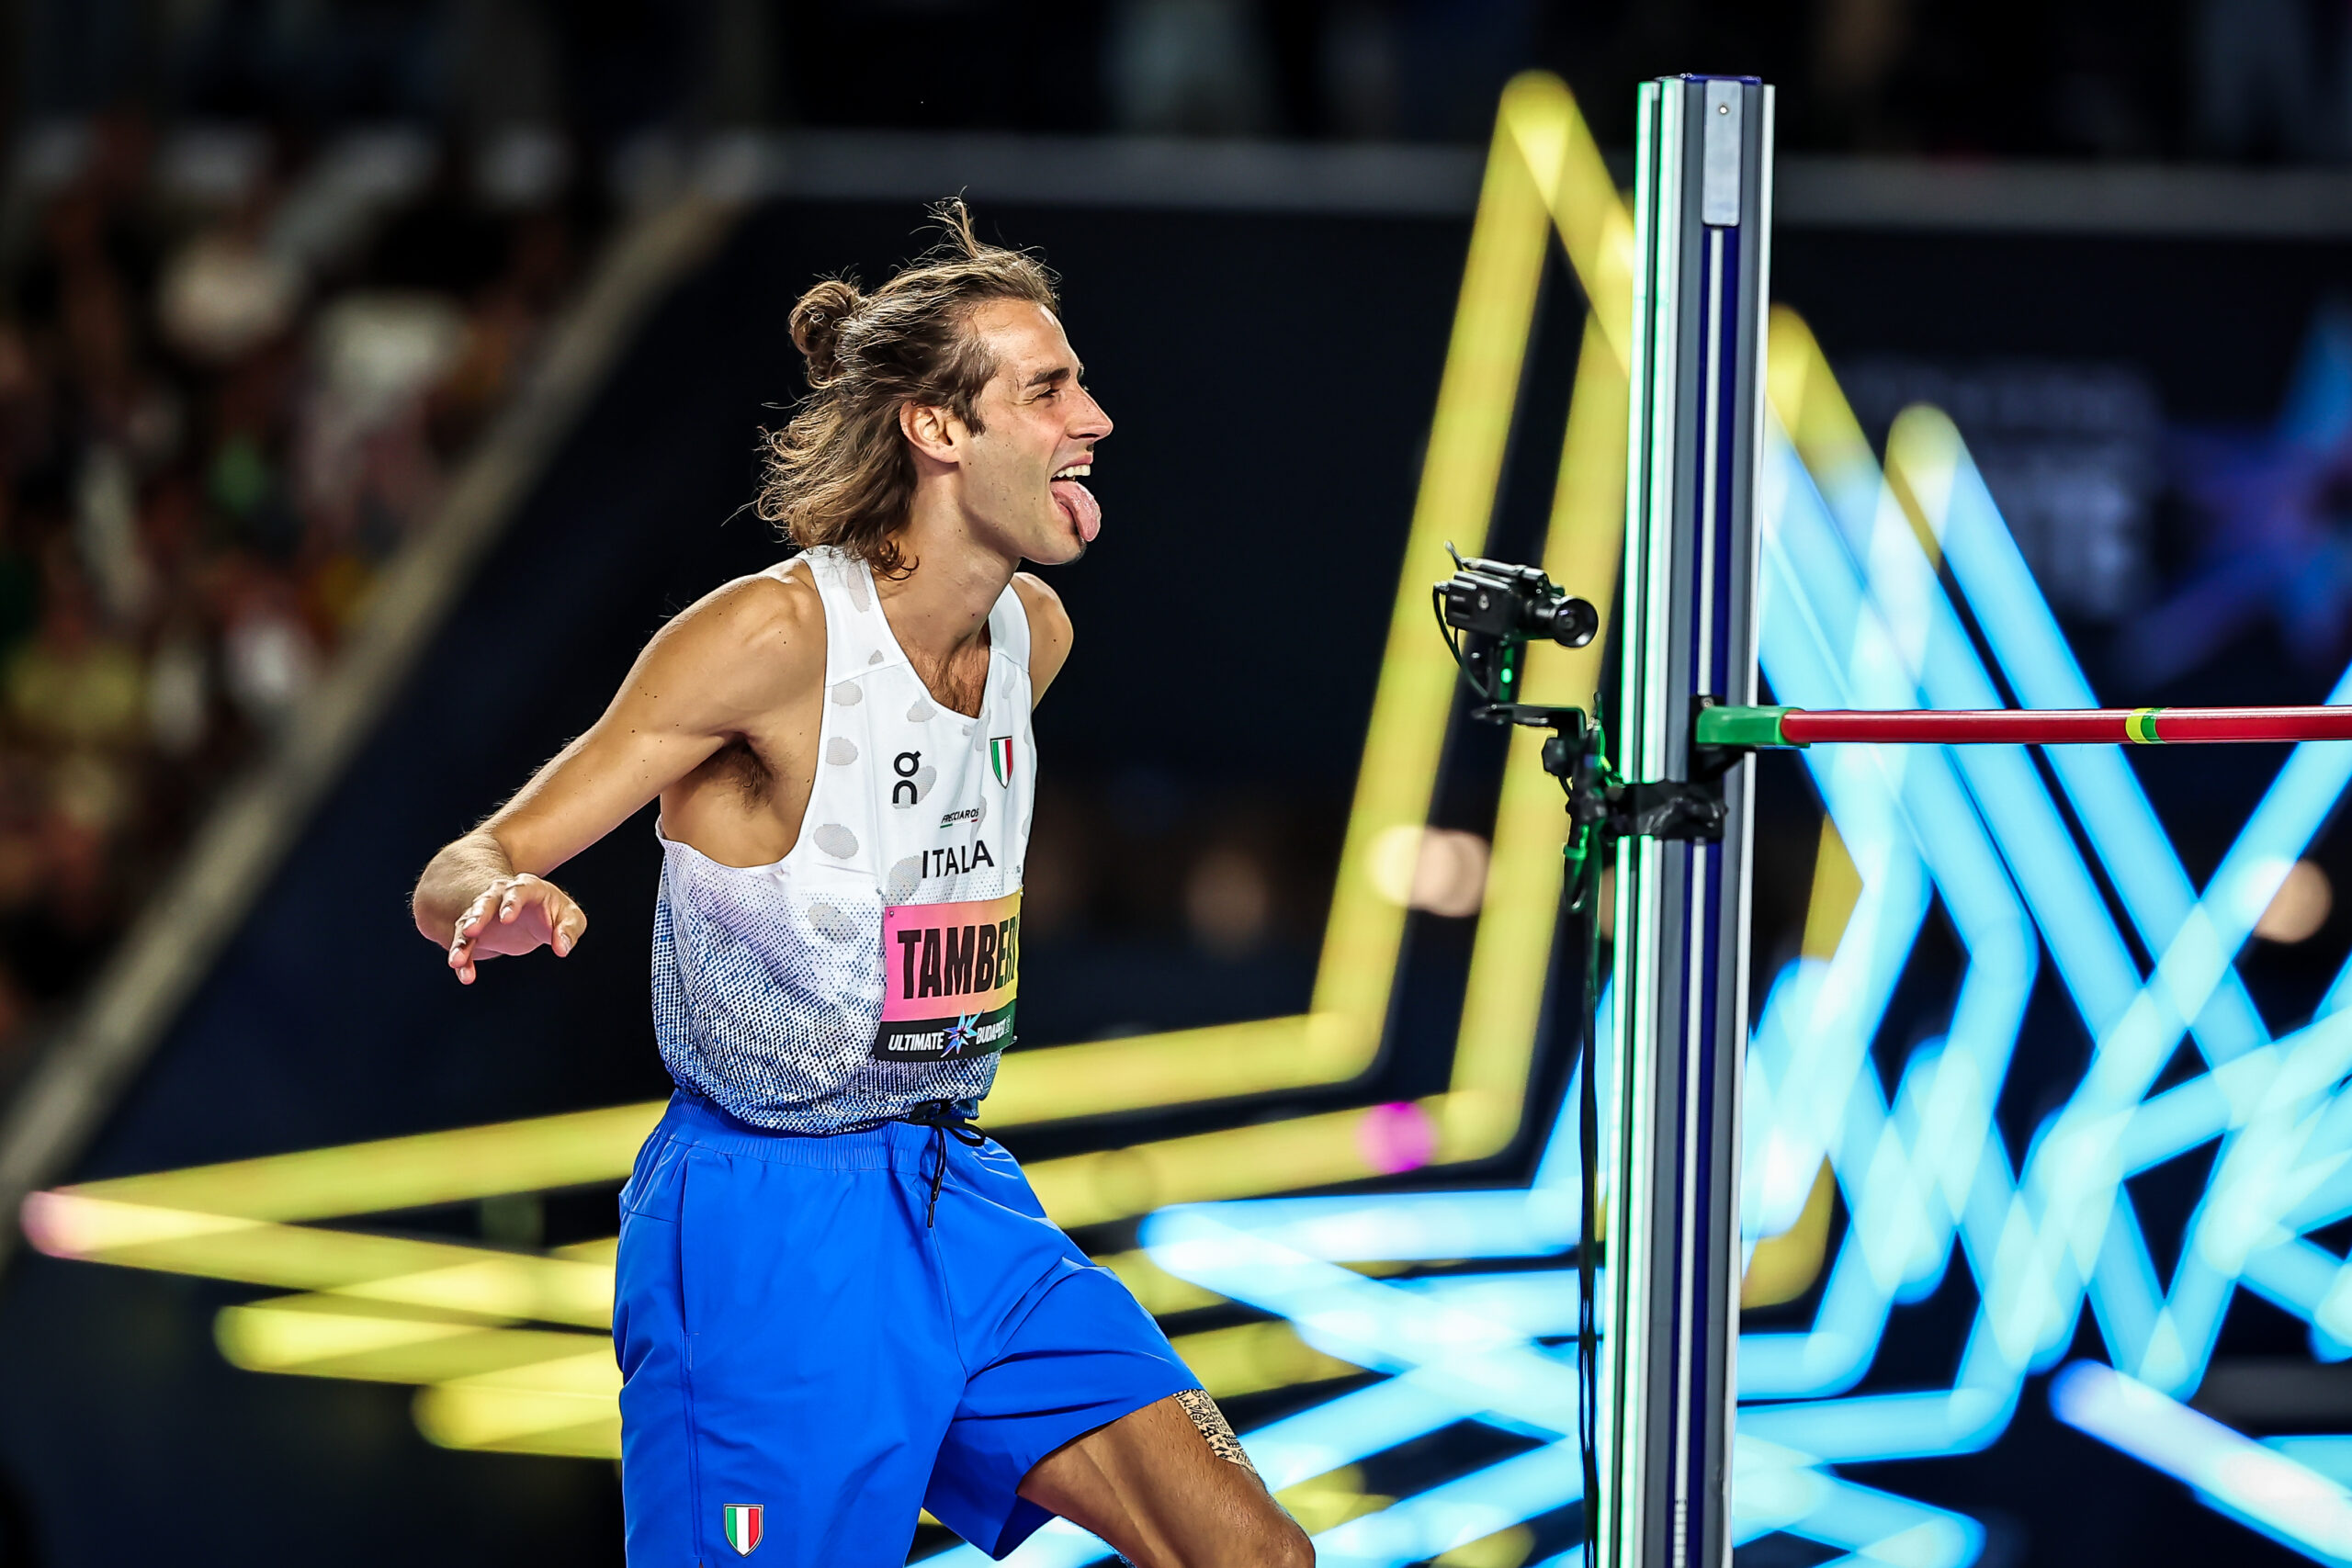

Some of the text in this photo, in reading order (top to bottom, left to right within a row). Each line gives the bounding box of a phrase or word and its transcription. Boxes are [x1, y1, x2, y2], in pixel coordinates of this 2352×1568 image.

[941, 807, 979, 823] FRECCIAROS
[922, 840, 994, 878] ITALA
[897, 913, 1019, 999] TAMBER
[888, 1032, 944, 1051] ULTIMATE
